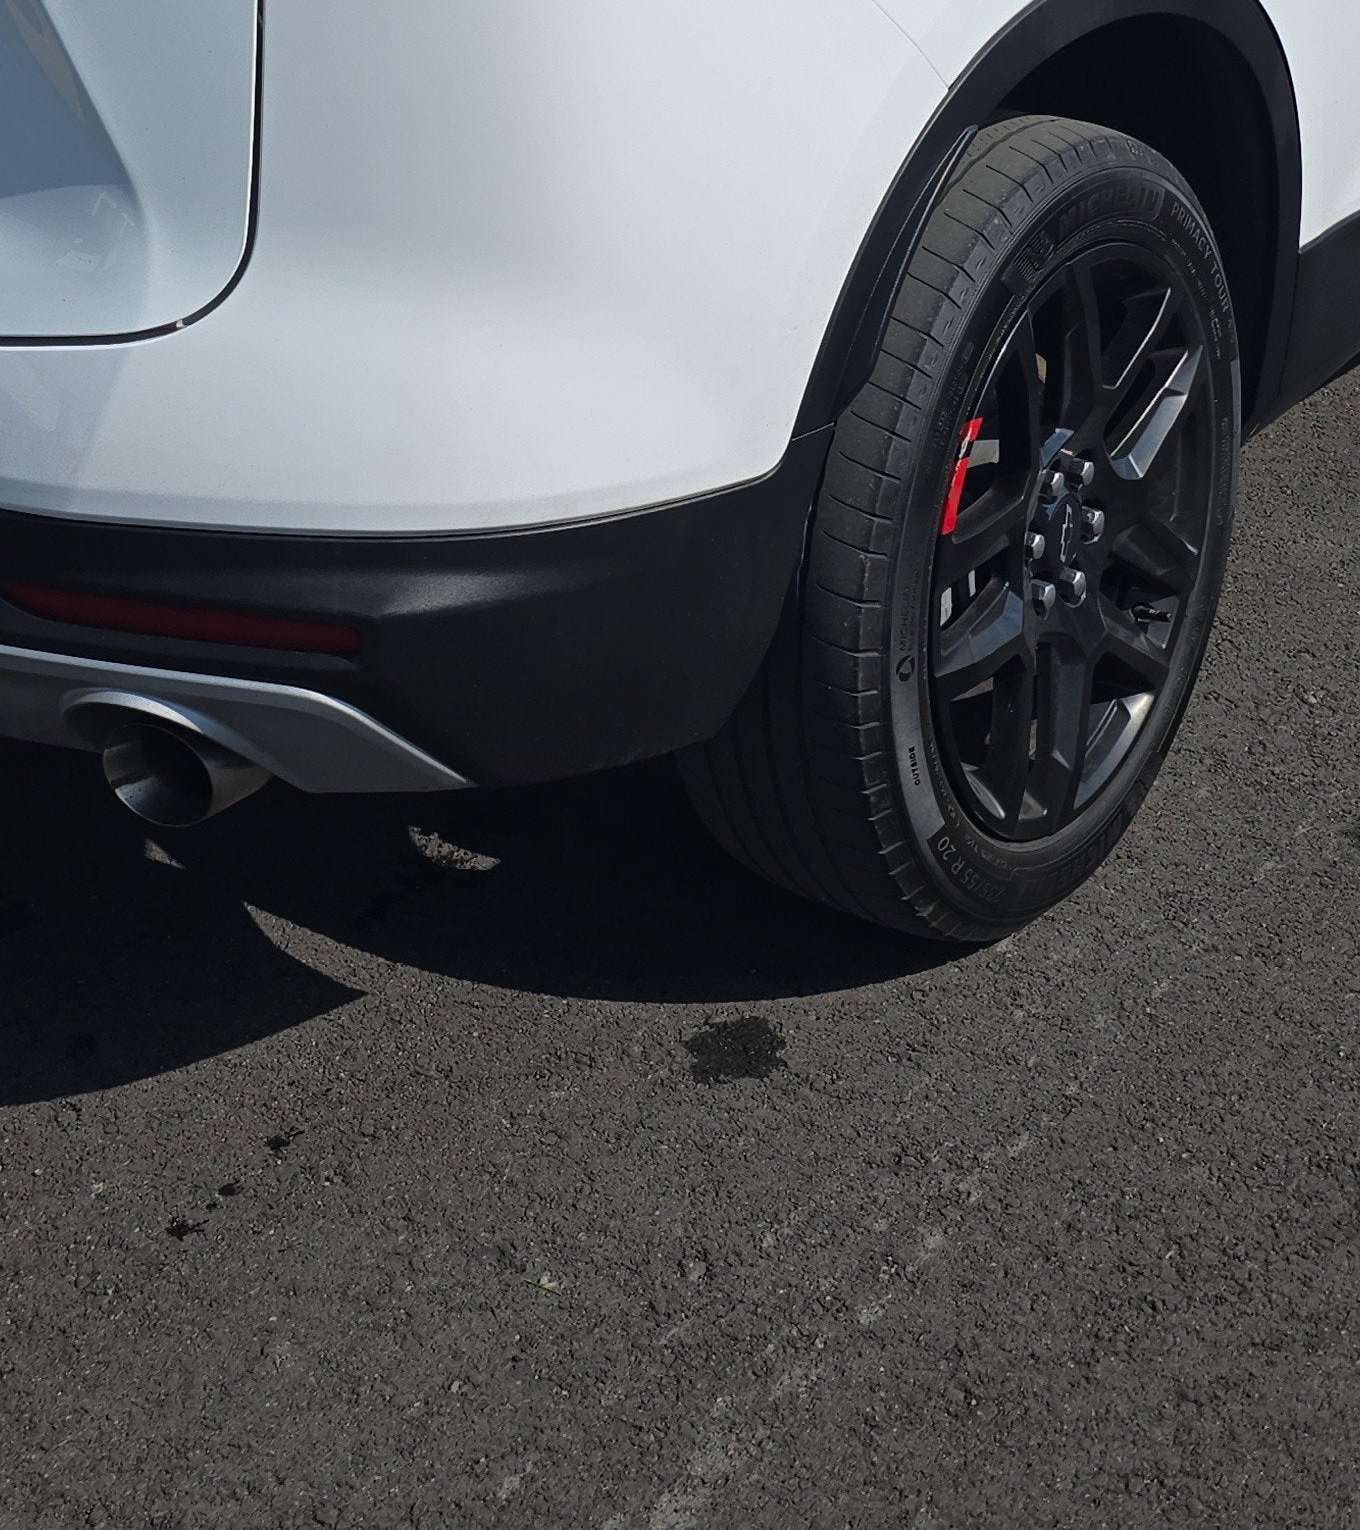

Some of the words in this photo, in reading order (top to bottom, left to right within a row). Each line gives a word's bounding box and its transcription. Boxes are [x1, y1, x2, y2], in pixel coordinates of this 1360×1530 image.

[1171, 201, 1213, 260] PRIMACY
[1209, 260, 1232, 313] TOUR
[908, 746, 921, 786] OUTSIDE
[937, 836, 957, 861] 20
[951, 856, 966, 876] R
